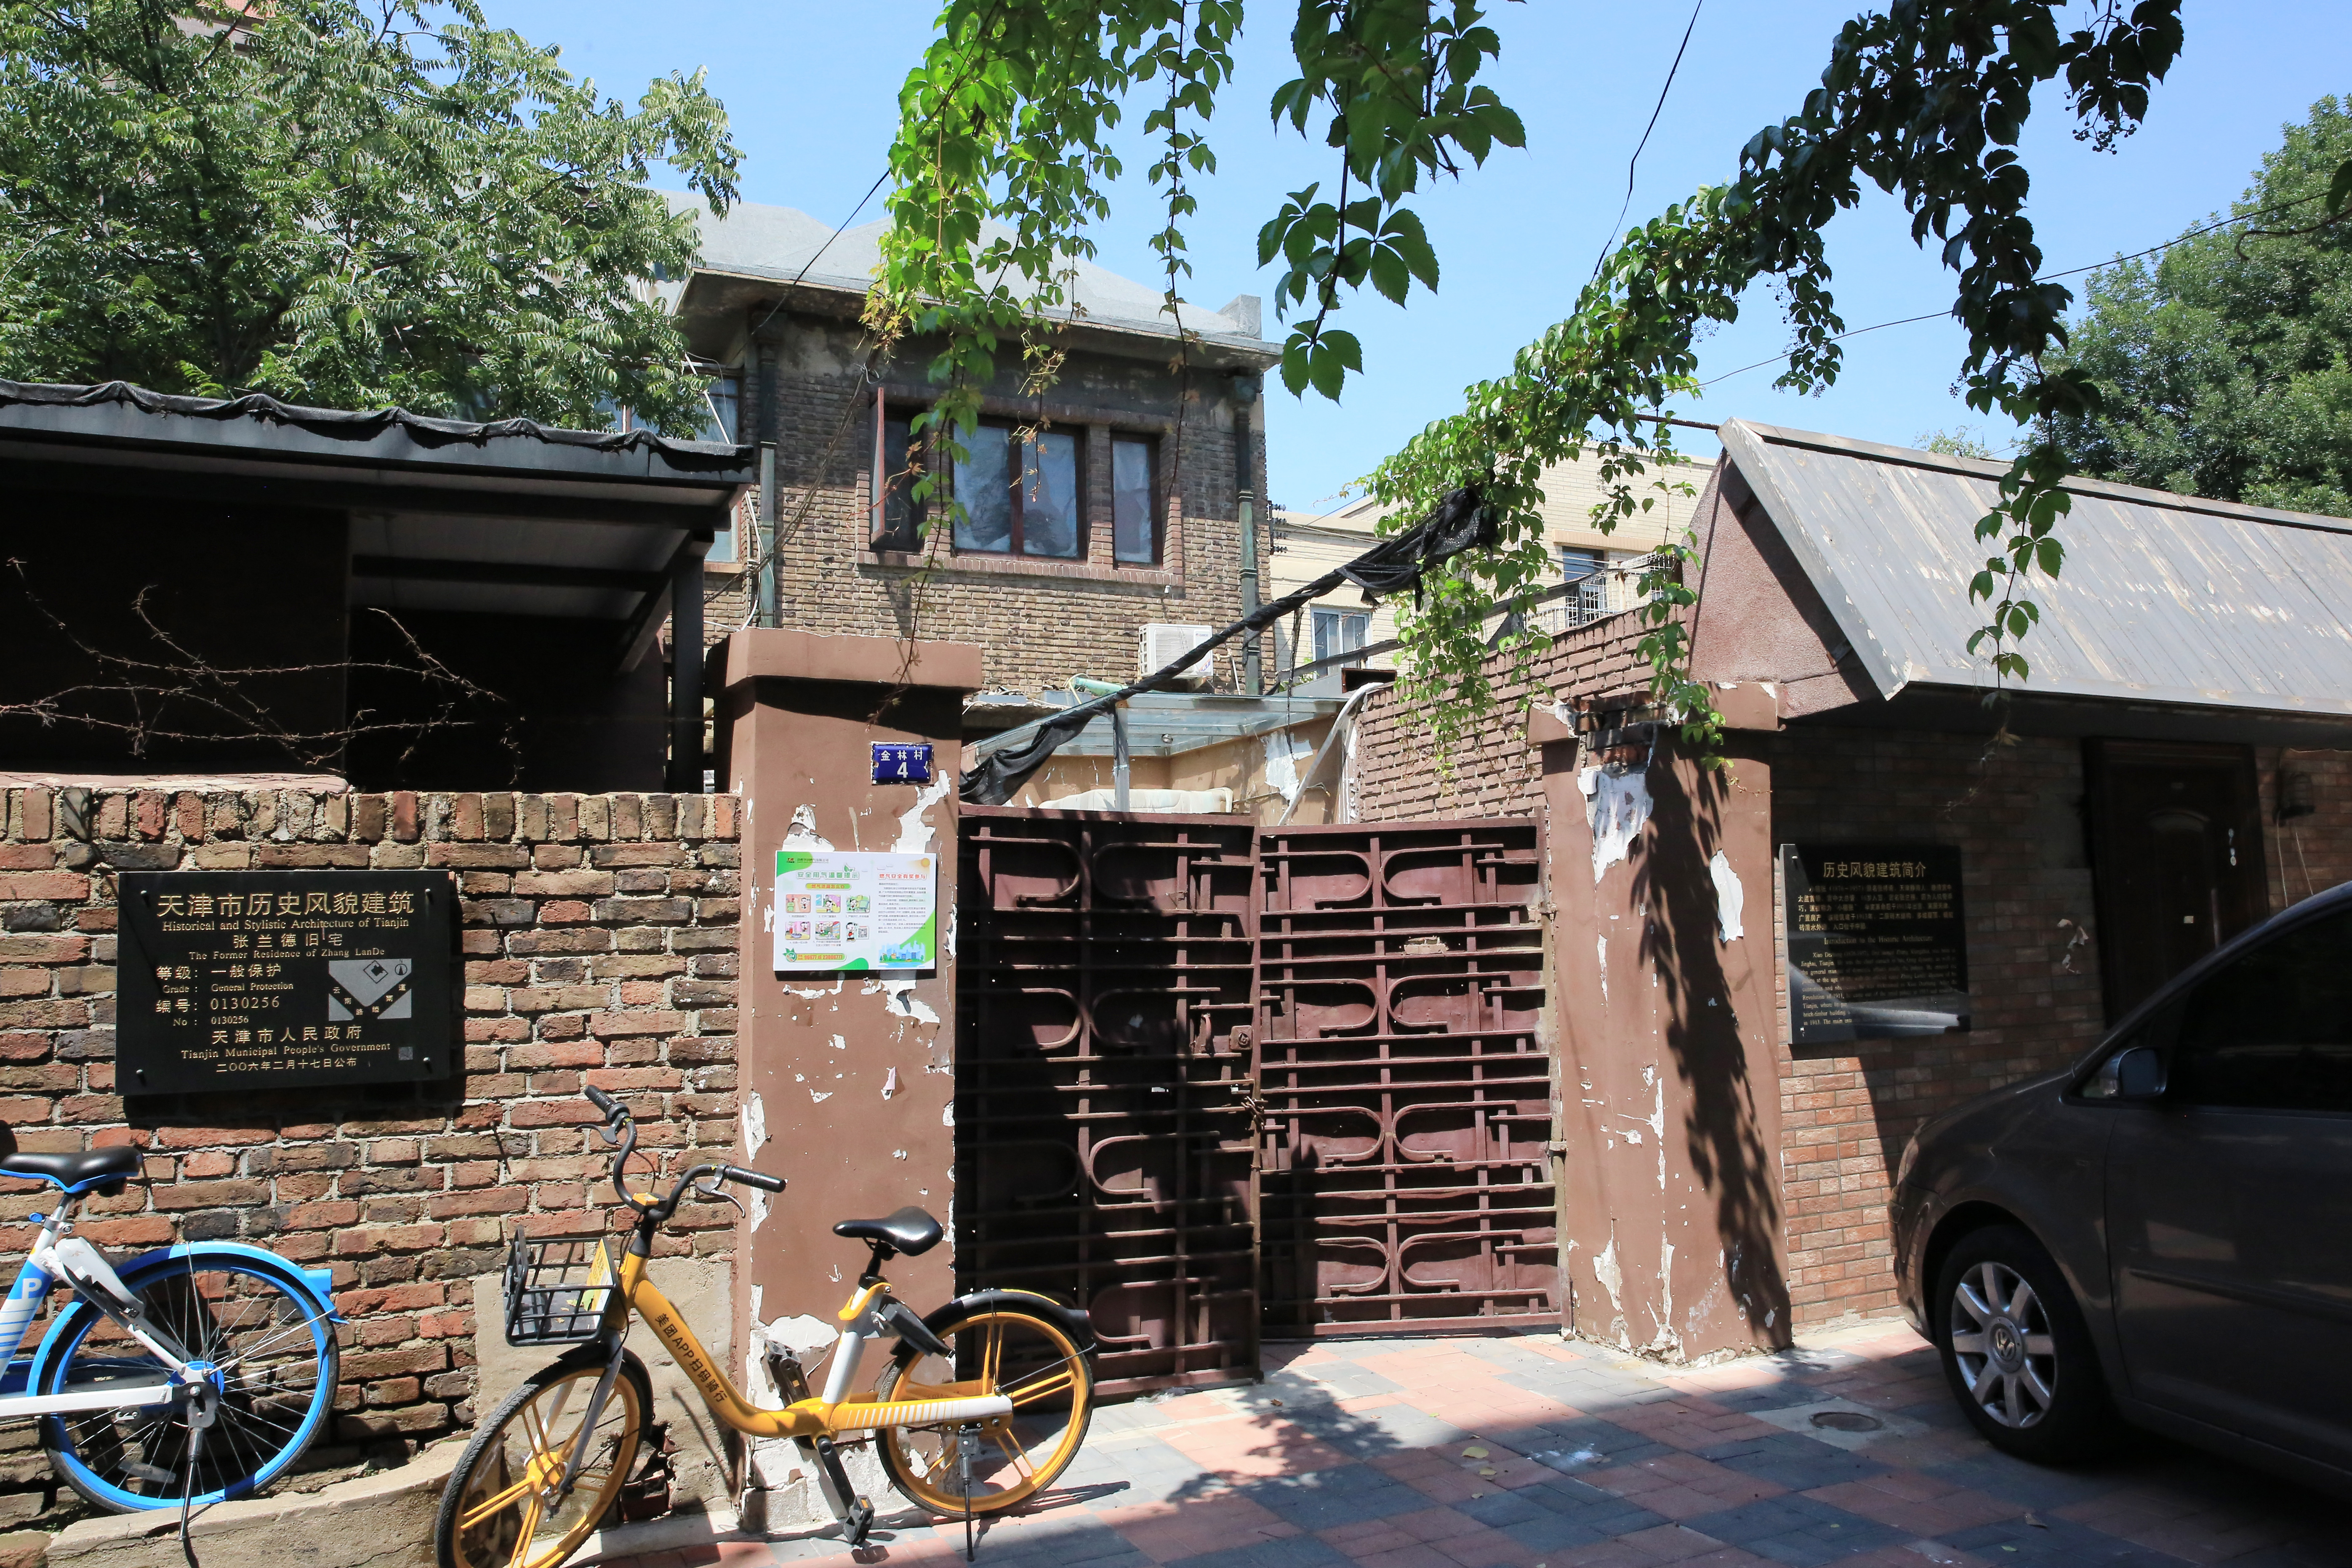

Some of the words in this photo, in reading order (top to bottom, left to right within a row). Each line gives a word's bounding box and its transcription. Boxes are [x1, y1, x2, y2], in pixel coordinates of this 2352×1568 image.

[880, 750, 923, 761] 金林村
[897, 762, 908, 778] 4
[1823, 862, 1926, 878] 历史风貌建筑简介
[157, 891, 415, 917] 天津市历史风貌建筑
[162, 921, 215, 931] Historical
[219, 920, 239, 930] and
[244, 919, 286, 932] Stylistic
[290, 918, 354, 930] Architecture
[358, 917, 371, 927] of
[373, 917, 409, 929] Tianjin
[233, 933, 342, 948] 张兰德旧宅
[213, 951, 248, 959] Former
[253, 950, 301, 958] Residence
[306, 948, 317, 957] of
[321, 949, 349, 958] Zhang
[210, 963, 281, 978] 一般保护
[163, 985, 189, 993] Grade
[211, 983, 245, 992] General
[250, 982, 294, 990] Protection
[210, 996, 280, 1010] 0130256
[173, 1018, 188, 1026] No
[211, 1015, 249, 1025] 0130256
[212, 1025, 361, 1045] 天津市人民政府
[181, 1049, 219, 1060] Tianjin
[225, 1046, 277, 1058] Municipal
[283, 1045, 324, 1056] People's
[330, 1043, 390, 1052] Government
[21, 1278, 42, 1299] P
[655, 1312, 727, 1402] 美团APP扫码骑行
